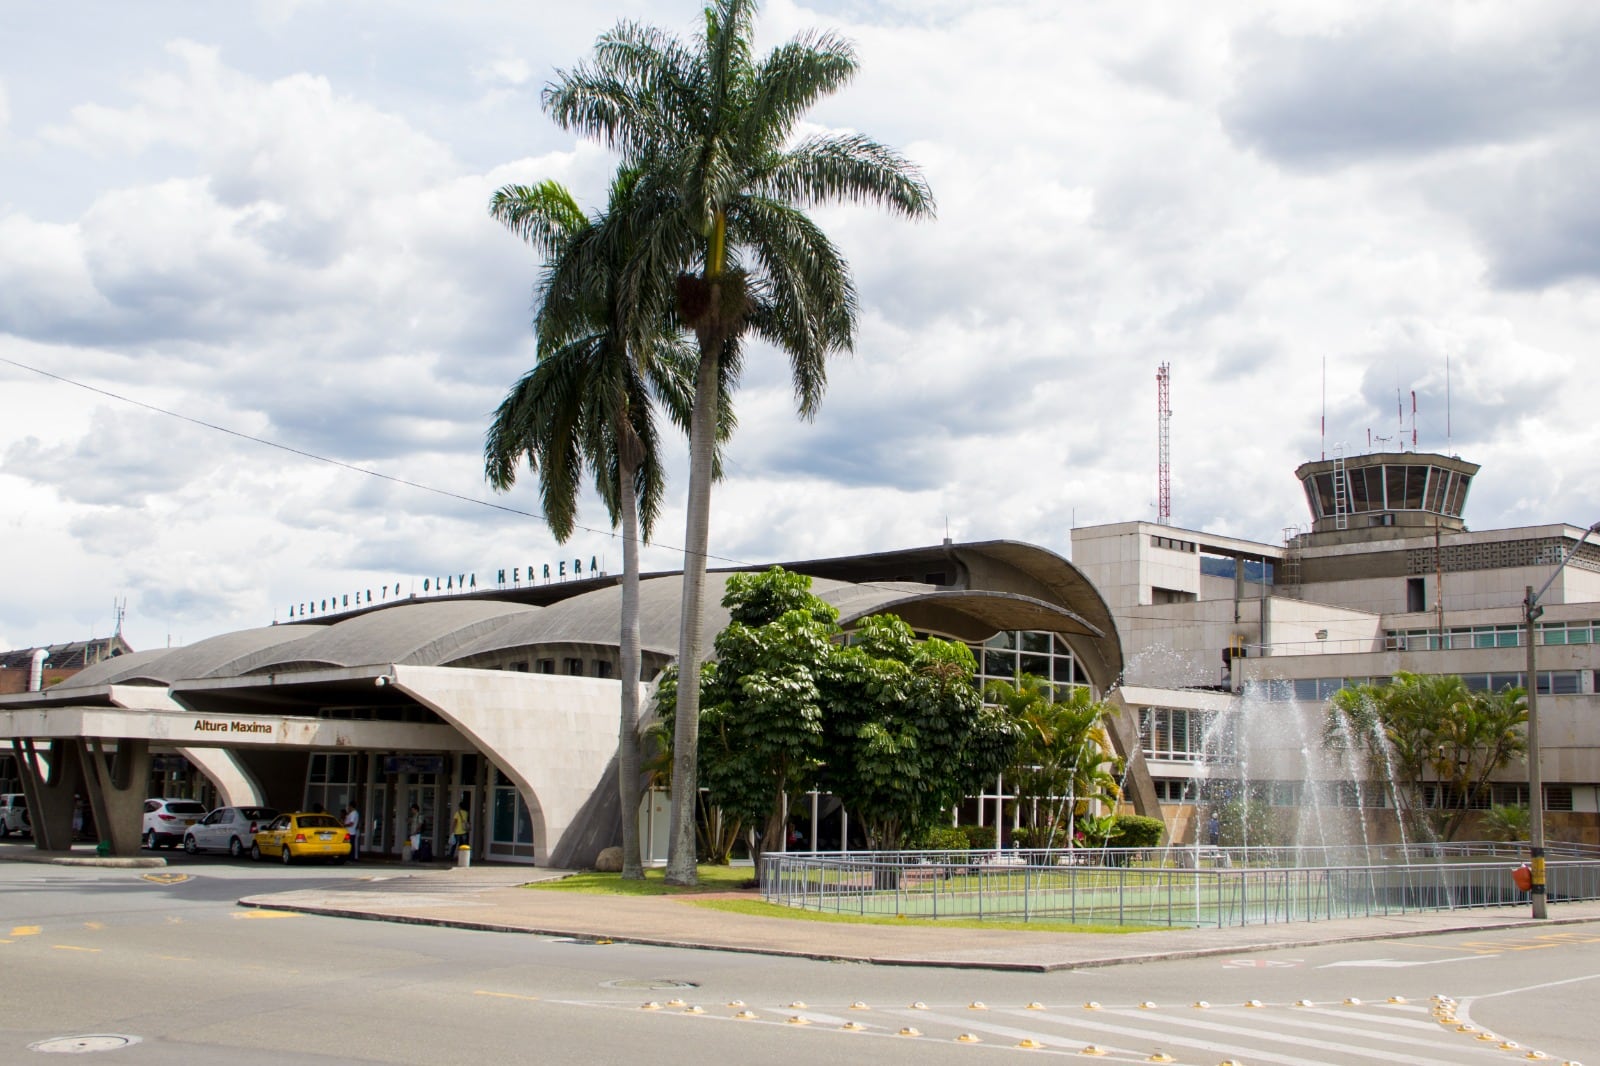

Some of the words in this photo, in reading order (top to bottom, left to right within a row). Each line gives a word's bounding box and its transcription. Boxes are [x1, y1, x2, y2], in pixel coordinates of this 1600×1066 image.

[290, 583, 400, 617] AEROPUERTO
[423, 573, 476, 592] OLAYA
[498, 555, 597, 584] HERRERA
[194, 720, 228, 732] Altura
[231, 721, 272, 734] Maxima
